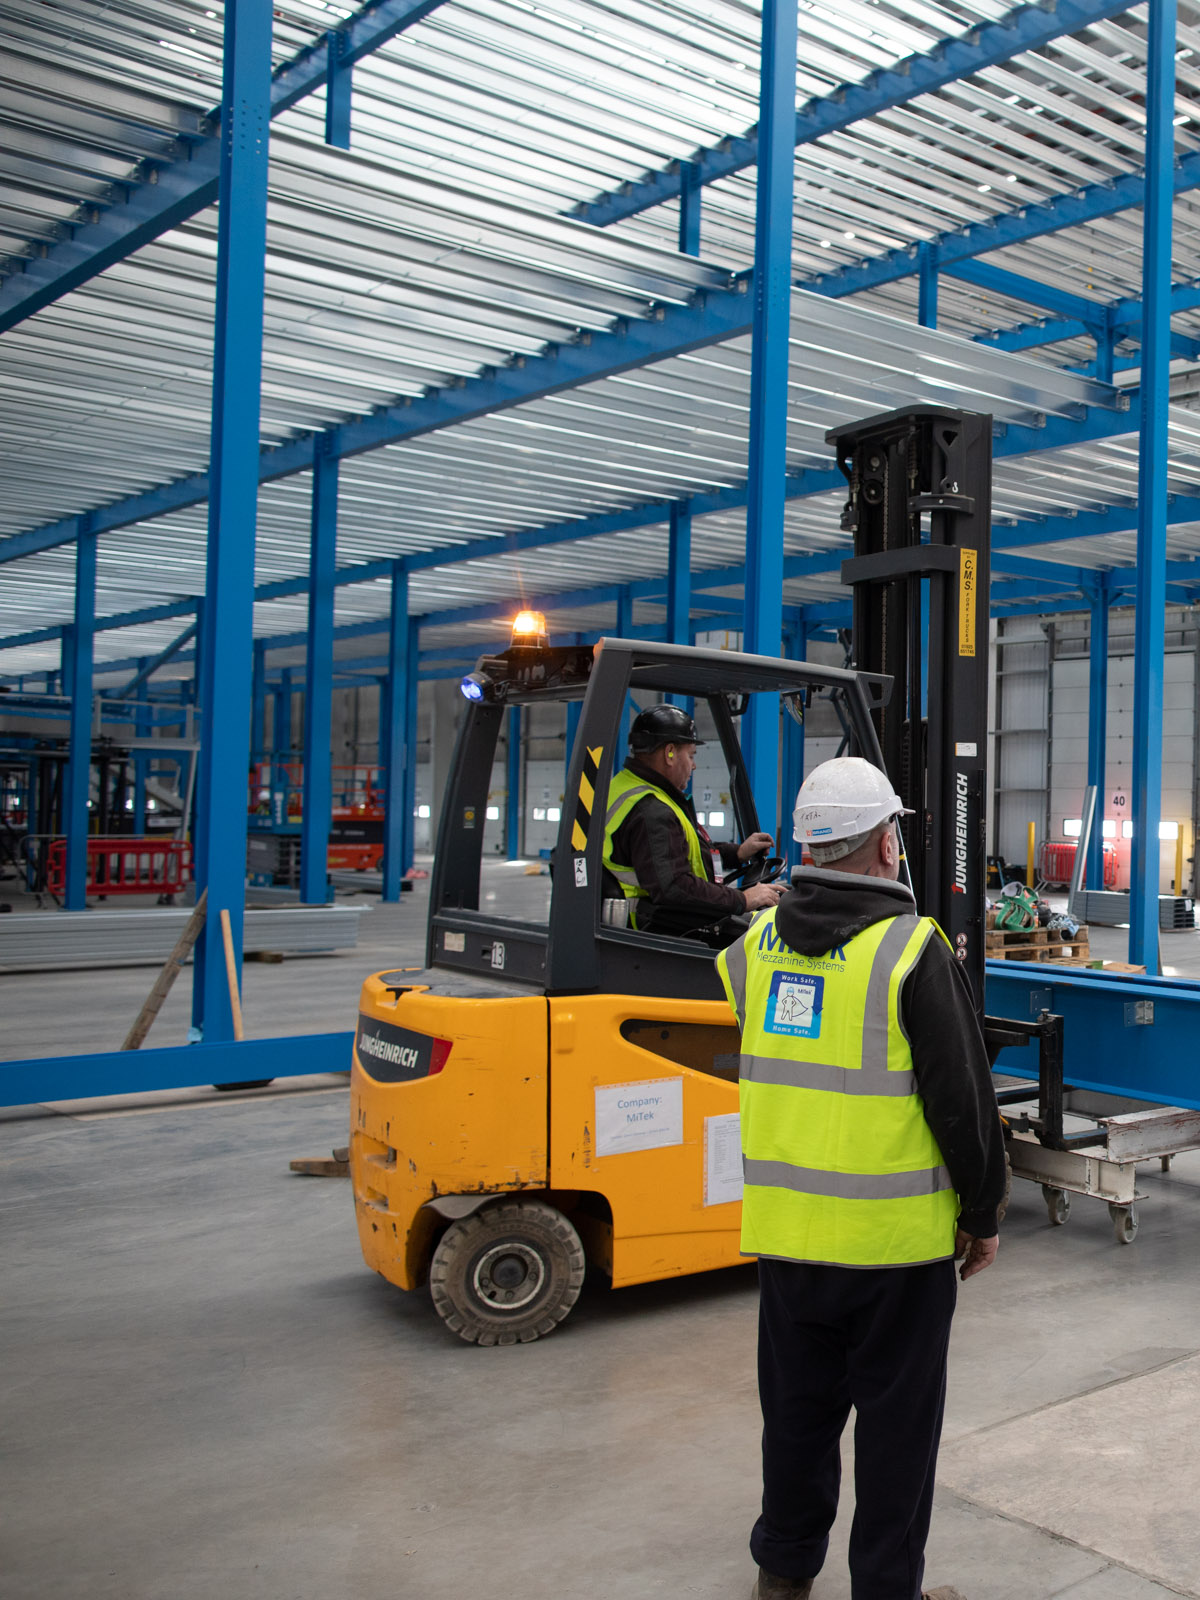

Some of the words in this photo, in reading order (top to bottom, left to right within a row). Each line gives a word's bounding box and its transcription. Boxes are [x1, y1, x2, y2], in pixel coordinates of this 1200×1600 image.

[1113, 795, 1125, 806] 40
[954, 772, 968, 895] JUNGHEINRICH
[492, 943, 504, 967] 13
[757, 951, 805, 967] Mezzanine
[806, 958, 846, 973] Systems
[781, 974, 798, 983] Work
[800, 977, 817, 985] Safe.
[772, 1025, 792, 1033] Home
[794, 1027, 811, 1036] Safe.
[359, 1031, 419, 1069] JUNGHEINRICH
[617, 1095, 663, 1110] Company:
[626, 1110, 654, 1123] MiTek
